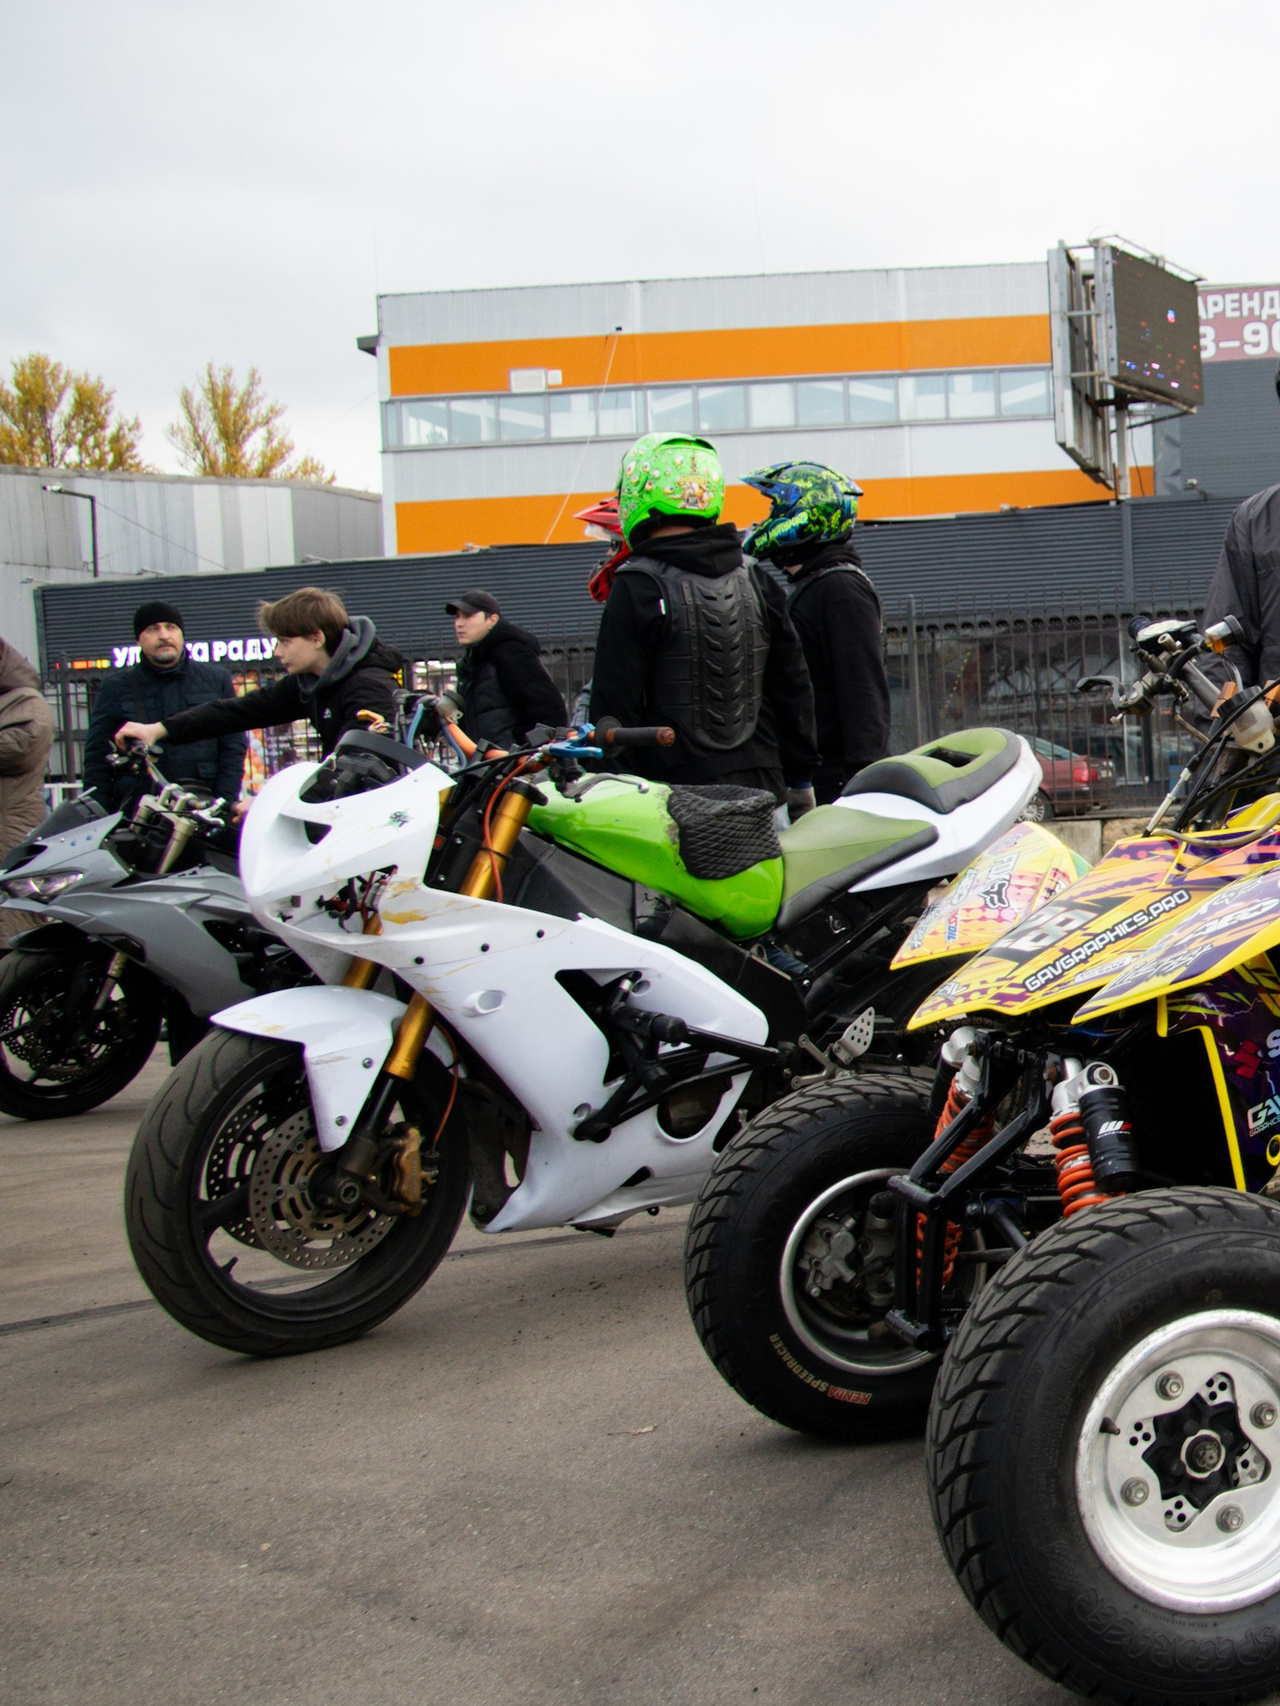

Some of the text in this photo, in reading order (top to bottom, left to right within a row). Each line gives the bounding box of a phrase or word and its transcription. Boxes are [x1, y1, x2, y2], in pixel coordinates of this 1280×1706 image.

[1024, 889, 1191, 992] GAVGRAPHICS.PRO
[769, 1333, 872, 1406] KENDA SPEEDRACER
